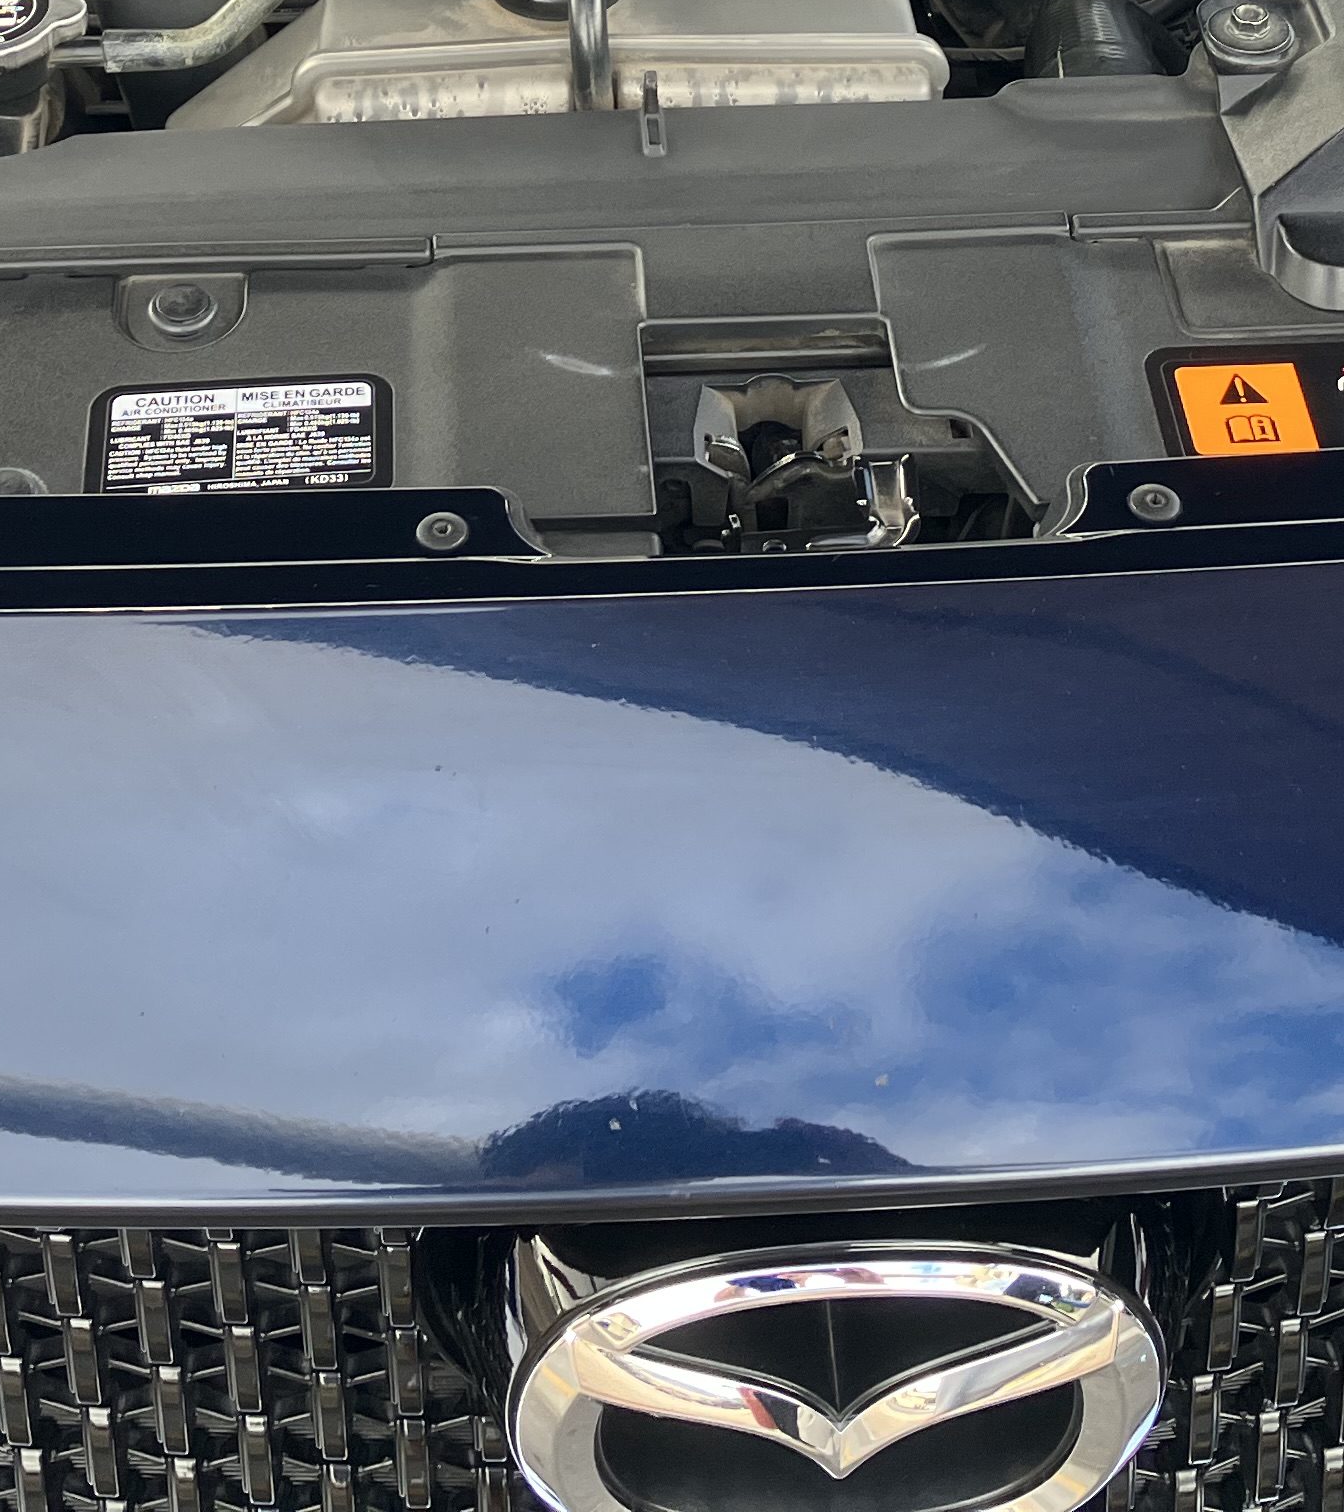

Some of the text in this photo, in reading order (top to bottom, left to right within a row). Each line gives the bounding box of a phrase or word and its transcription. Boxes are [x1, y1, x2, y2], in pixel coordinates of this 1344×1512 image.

[136, 394, 215, 408] CAUTION
[241, 387, 366, 402] MISE EN GARDE
[263, 398, 342, 408] CLIMATISEUR
[121, 404, 226, 417] AIR CONDITIONER
[304, 474, 349, 485] (KD33)
